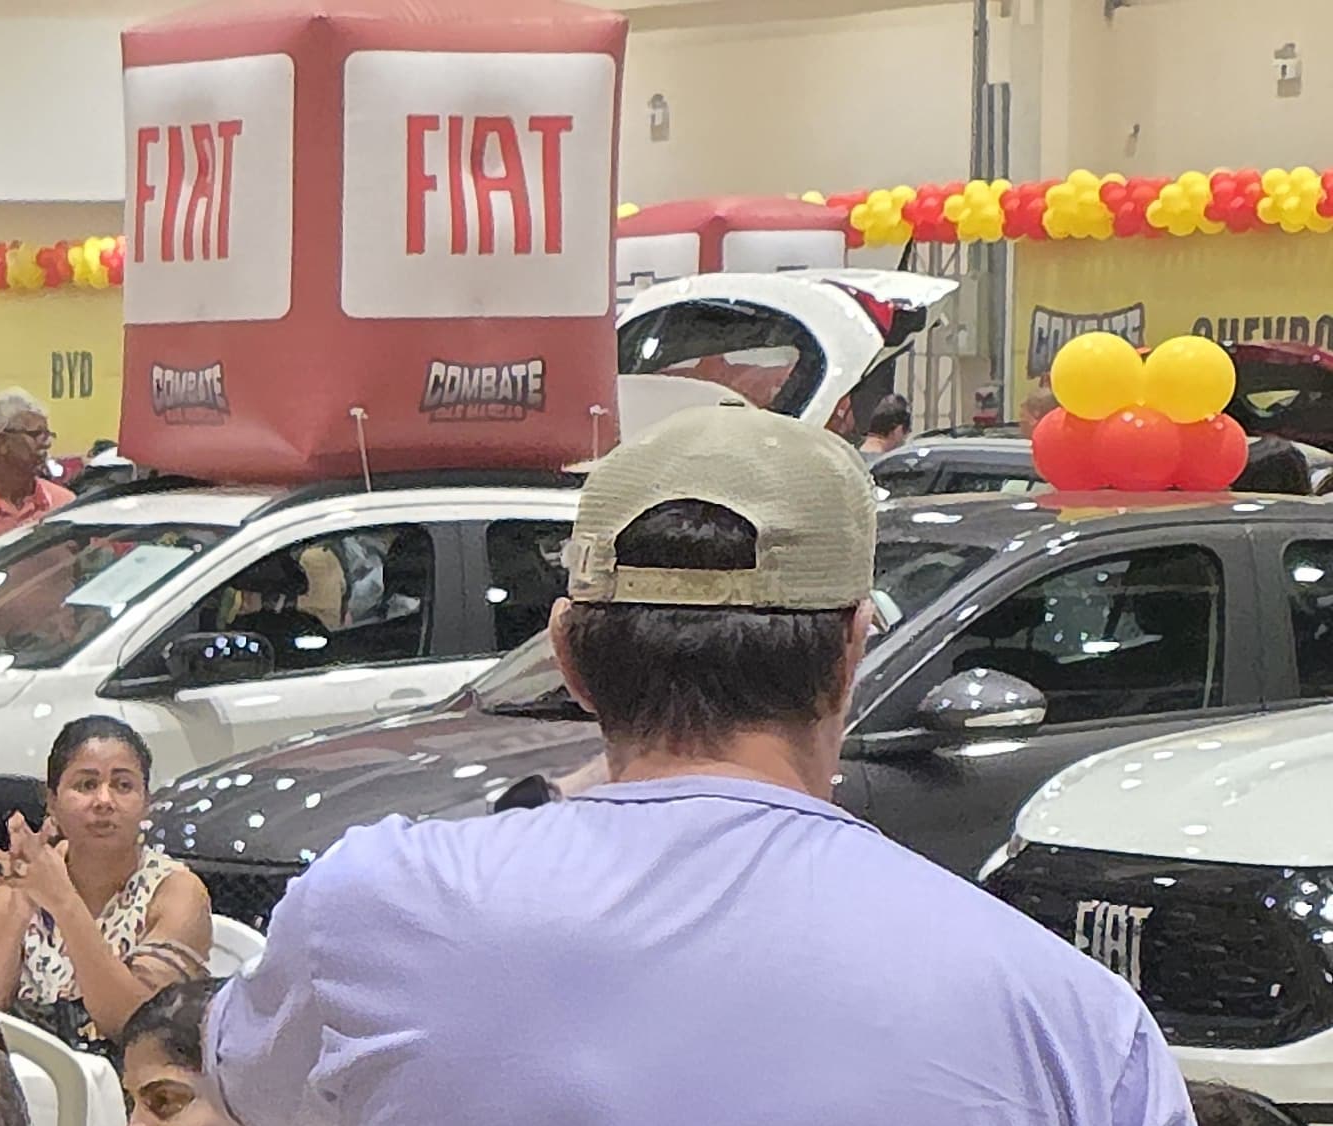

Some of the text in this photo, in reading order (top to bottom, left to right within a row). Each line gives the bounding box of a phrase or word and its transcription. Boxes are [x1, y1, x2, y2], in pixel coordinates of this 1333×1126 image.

[134, 119, 243, 262] FIAT
[406, 114, 573, 255] FIAT
[51, 351, 93, 399] BYD
[153, 364, 226, 411] COMBATE
[424, 360, 543, 407] COMBATE
[1075, 899, 1154, 991] FIAT
